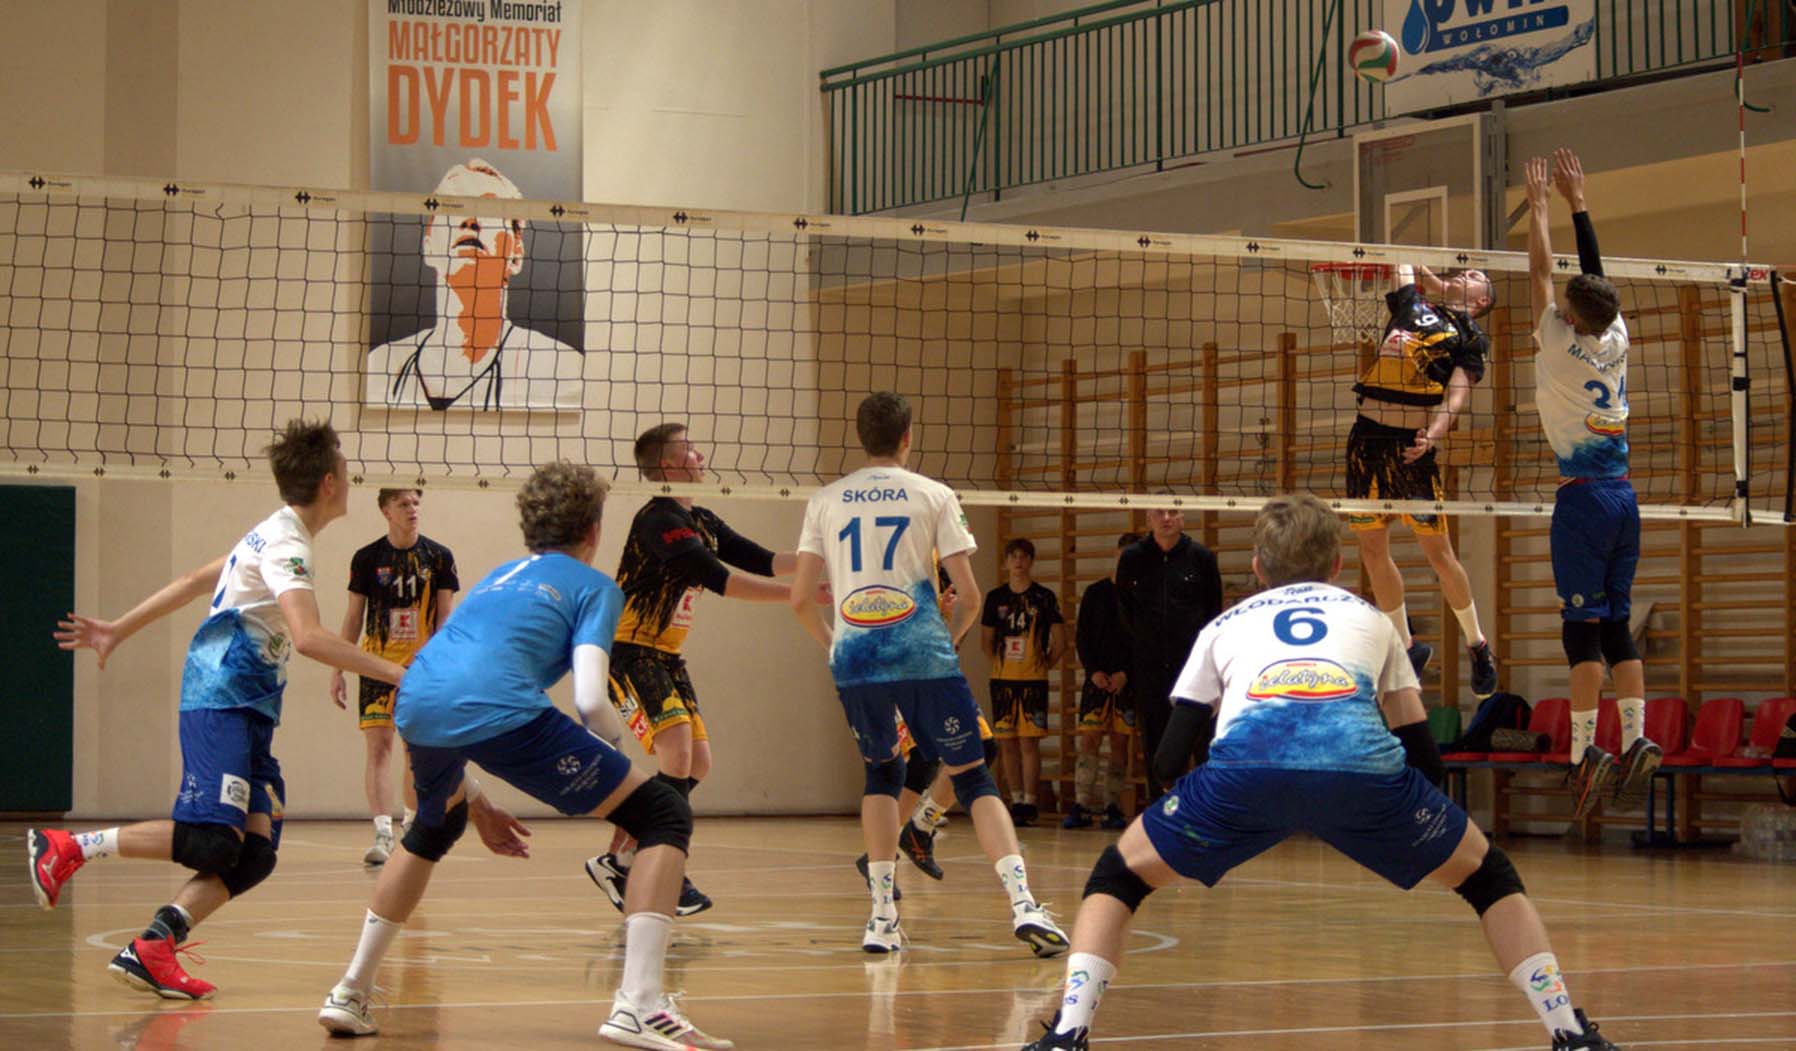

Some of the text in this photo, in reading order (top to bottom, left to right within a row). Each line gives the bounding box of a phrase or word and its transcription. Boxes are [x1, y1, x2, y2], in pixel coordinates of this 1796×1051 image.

[388, 20, 562, 67] MAŁGORZATY
[1443, 15, 1545, 44] WOŁOMIN
[388, 65, 559, 151] DYDEK
[842, 486, 909, 503] SKÓRA
[838, 516, 911, 573] 17
[392, 575, 417, 598] 11
[1007, 612, 1026, 629] 14
[1273, 607, 1328, 646] 6
